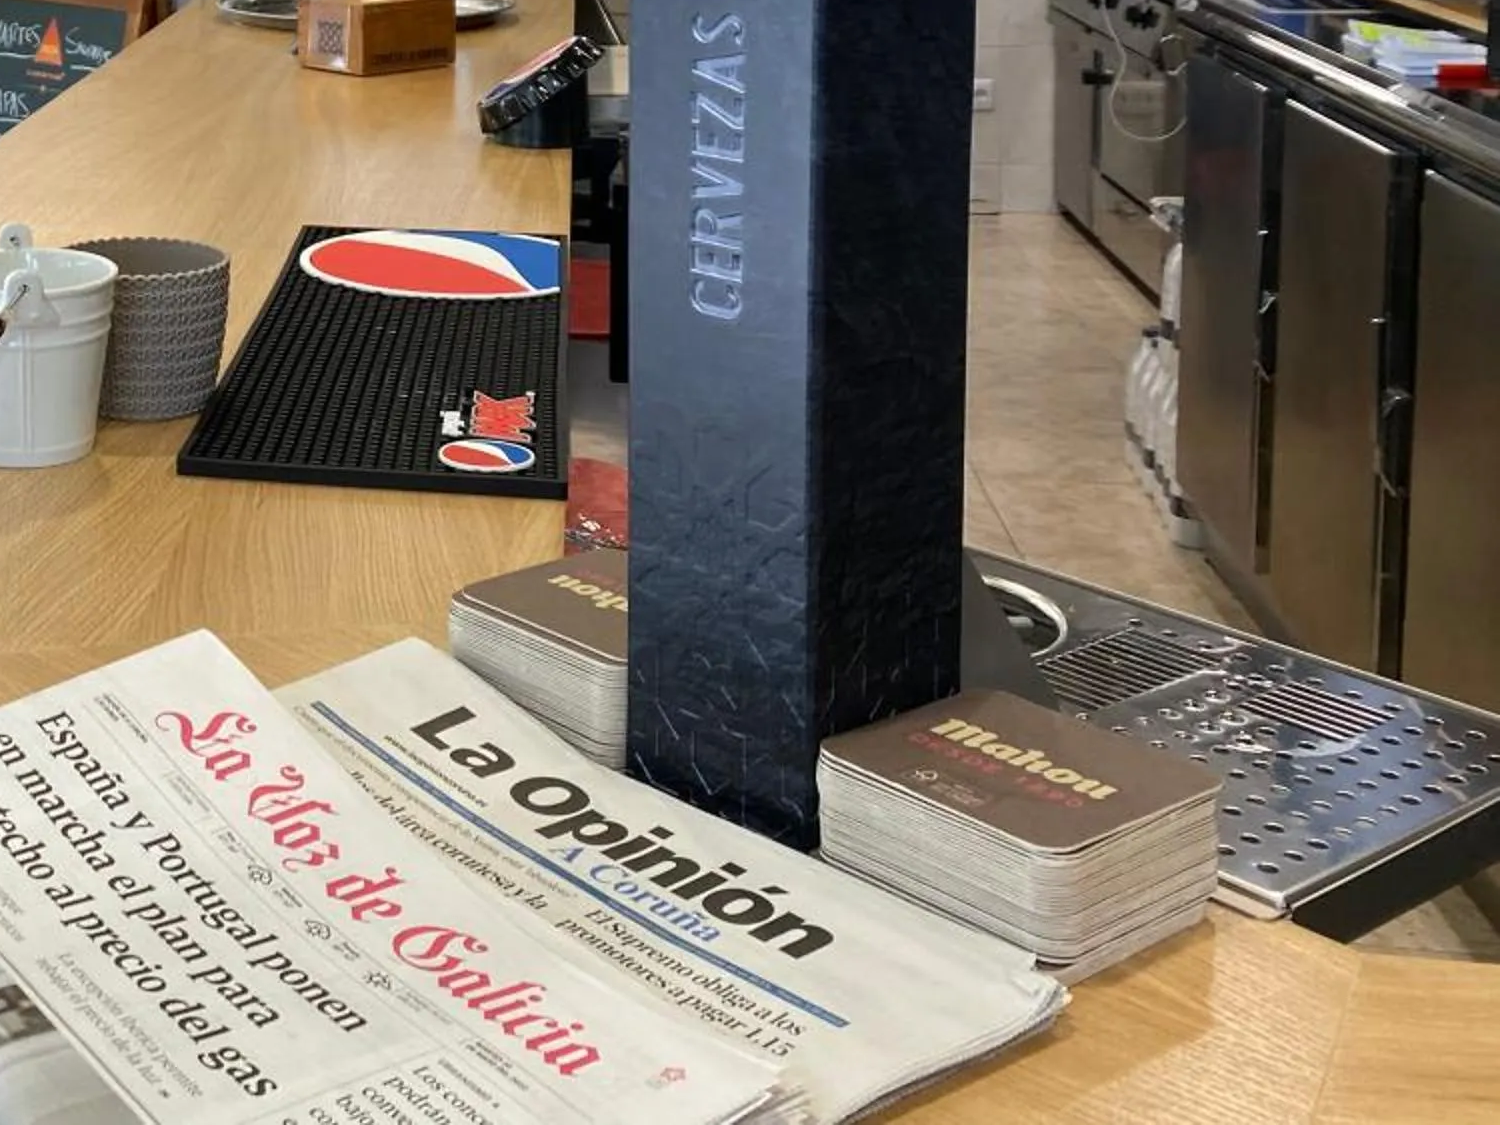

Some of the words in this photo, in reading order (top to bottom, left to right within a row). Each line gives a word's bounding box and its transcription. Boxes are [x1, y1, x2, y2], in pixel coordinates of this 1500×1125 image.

[688, 9, 746, 325] CERVEZAS
[931, 717, 1121, 801] Mahou
[16, 766, 117, 873] marcha
[409, 705, 516, 779] La
[509, 776, 836, 960] Opinión
[36, 710, 131, 811] España
[110, 812, 155, 831] y
[142, 832, 279, 951] Portugal
[247, 951, 368, 1033] ponen
[45, 881, 94, 911] al
[108, 875, 155, 901] el
[154, 711, 258, 782] La
[248, 765, 339, 874] Voz
[325, 866, 406, 923] de
[391, 925, 603, 1076] Galicia
[548, 844, 583, 864] A
[589, 863, 722, 944] Coruña
[61, 913, 168, 995] precio
[123, 901, 208, 963] plan
[585, 908, 609, 929] El
[609, 921, 694, 981] Supremo
[690, 968, 757, 1015] obliga
[755, 1004, 772, 1017] a
[771, 1009, 807, 1037] los
[160, 997, 231, 1044] del
[189, 965, 281, 1029] para
[555, 918, 672, 994] promotores
[667, 988, 683, 1004] a
[676, 993, 748, 1034] pagar
[745, 1026, 796, 1059] 1,15
[197, 1046, 279, 1099] gas
[412, 1065, 444, 1092] Los
